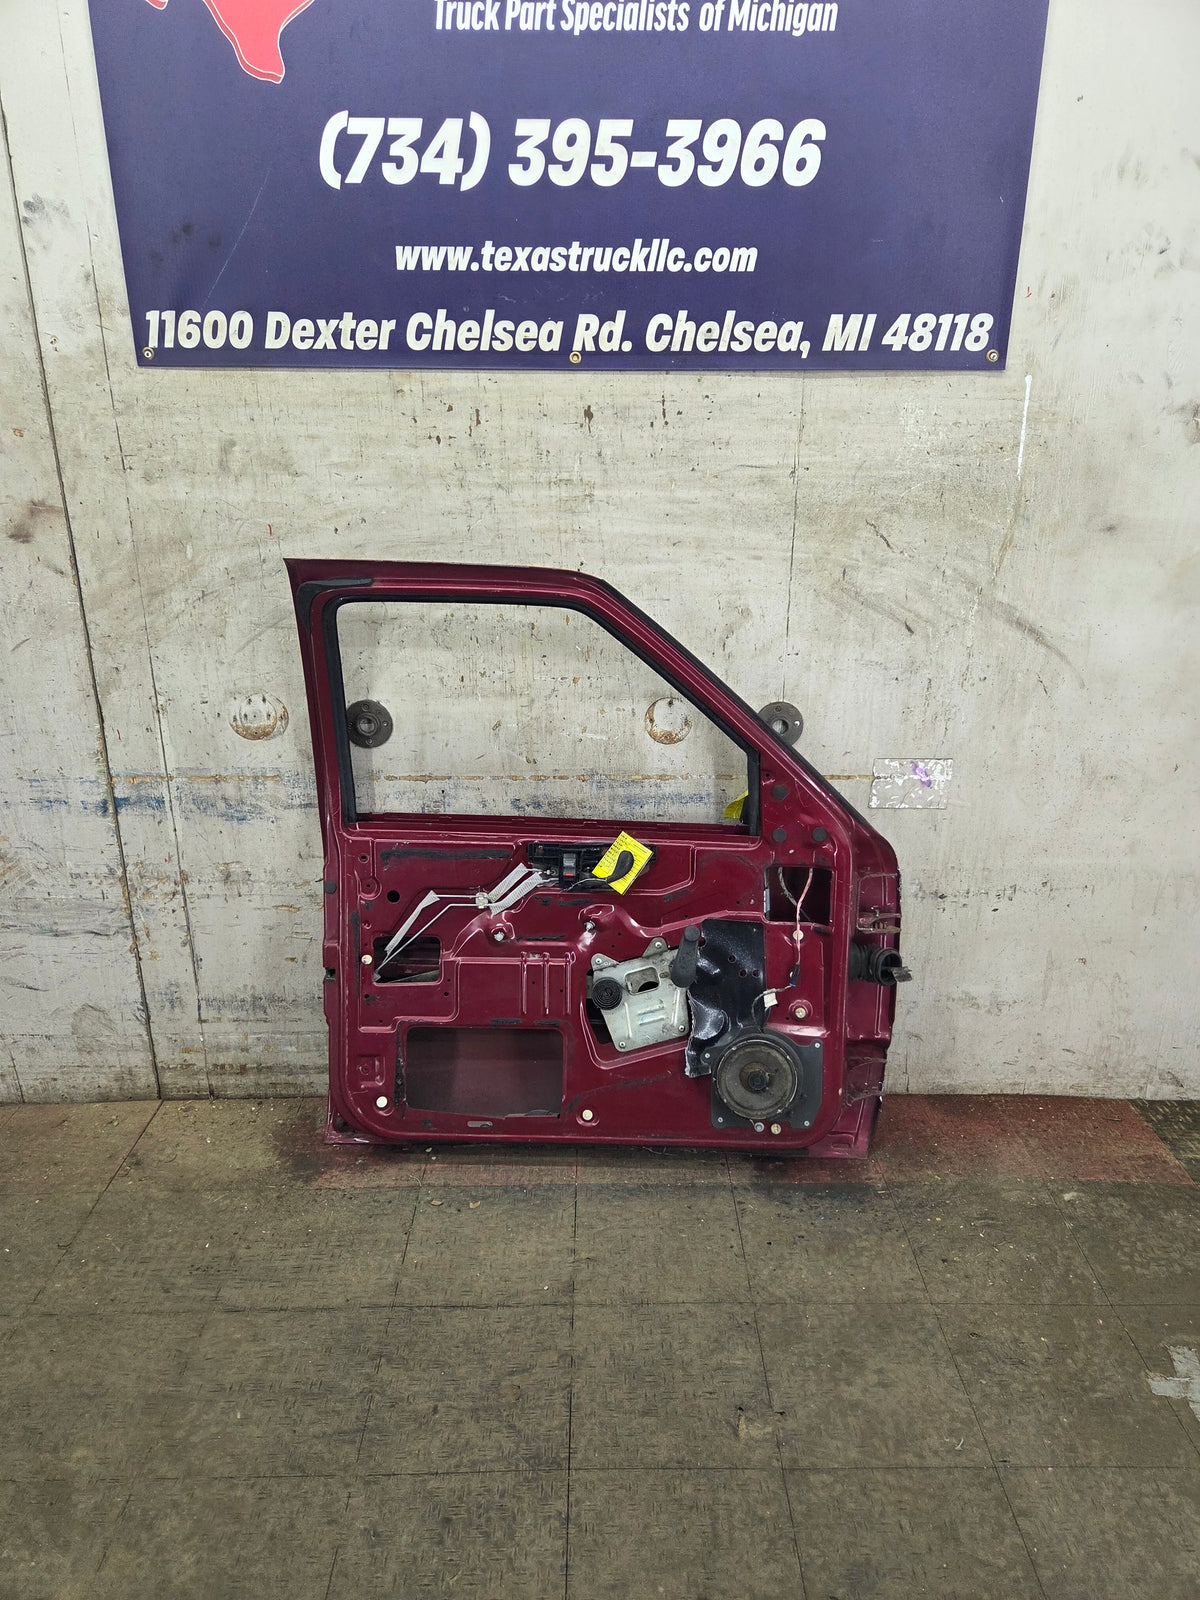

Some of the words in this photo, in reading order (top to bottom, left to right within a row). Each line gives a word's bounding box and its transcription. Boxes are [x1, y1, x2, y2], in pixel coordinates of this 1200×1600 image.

[434, 0, 500, 30] Truck
[504, 0, 557, 31] Part
[560, 0, 690, 36] Specialists
[699, 0, 725, 32] of
[727, 0, 838, 37] Michigan
[318, 111, 491, 192] (734)
[508, 117, 826, 189] 395-3966
[394, 239, 758, 273] www.texastruckllc.com
[145, 310, 253, 350] 11600
[264, 311, 396, 350] Dexter
[406, 309, 564, 352] Chelsea
[572, 310, 633, 352] Rd.
[645, 310, 810, 359] Chelsea,
[822, 313, 877, 352] MI
[881, 313, 994, 353] 48118
